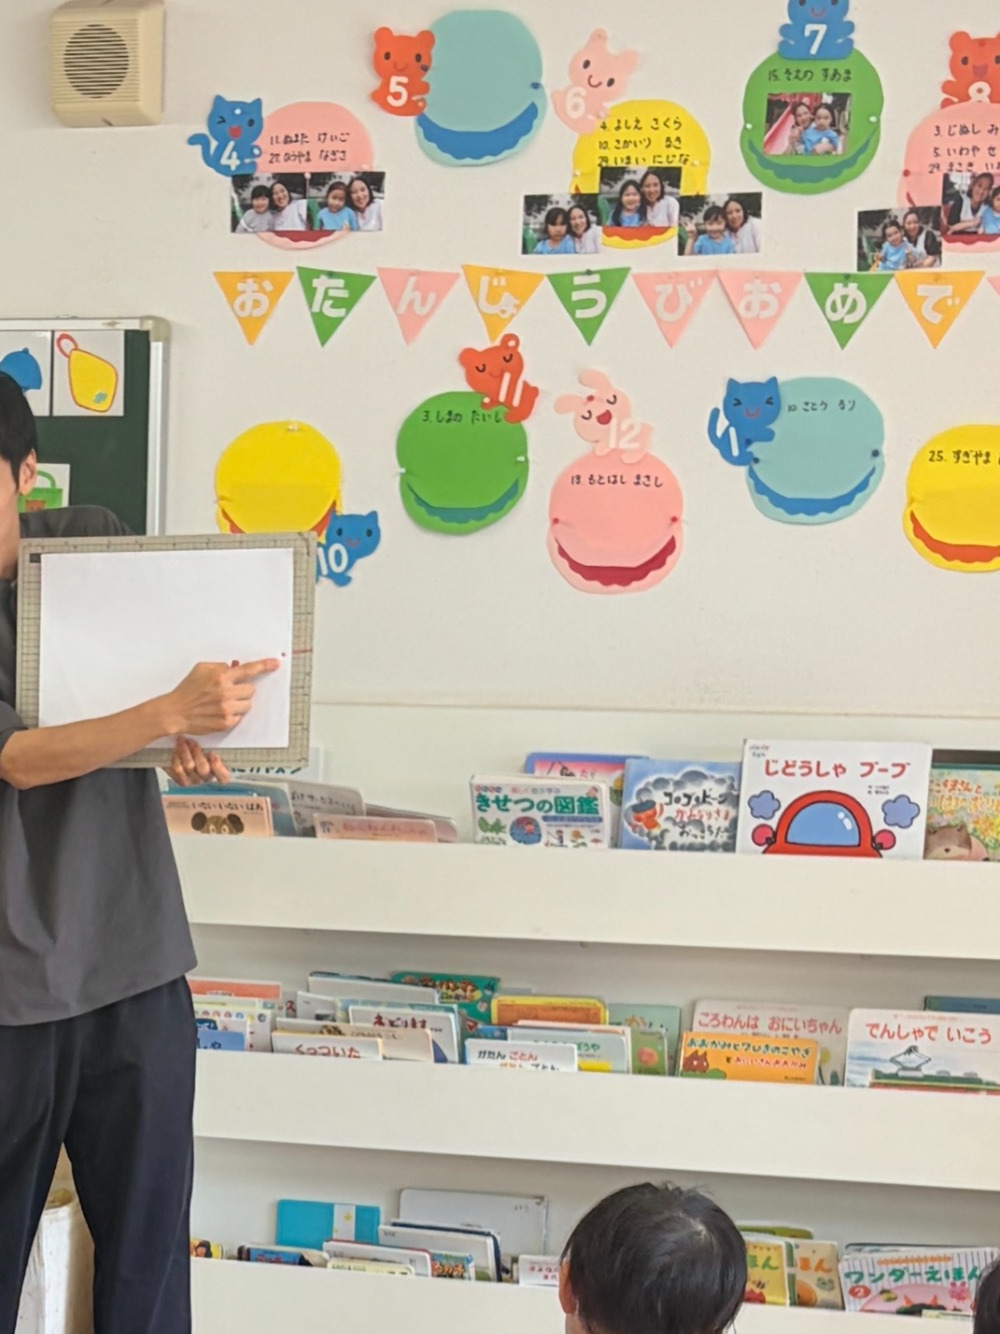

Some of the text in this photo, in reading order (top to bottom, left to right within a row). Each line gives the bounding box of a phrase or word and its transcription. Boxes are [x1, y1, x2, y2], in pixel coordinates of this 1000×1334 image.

[804, 23, 827, 55] 7
[387, 76, 409, 107] 5
[566, 86, 586, 117] 6
[219, 141, 241, 171] 4
[317, 543, 348, 576] 10
[764, 759, 911, 778] じどうしゃ ブーブ
[476, 792, 599, 815] きせつの図鑑
[768, 1015, 842, 1035] おにいちゃん
[865, 1023, 991, 1044] でんしゃで いこう
